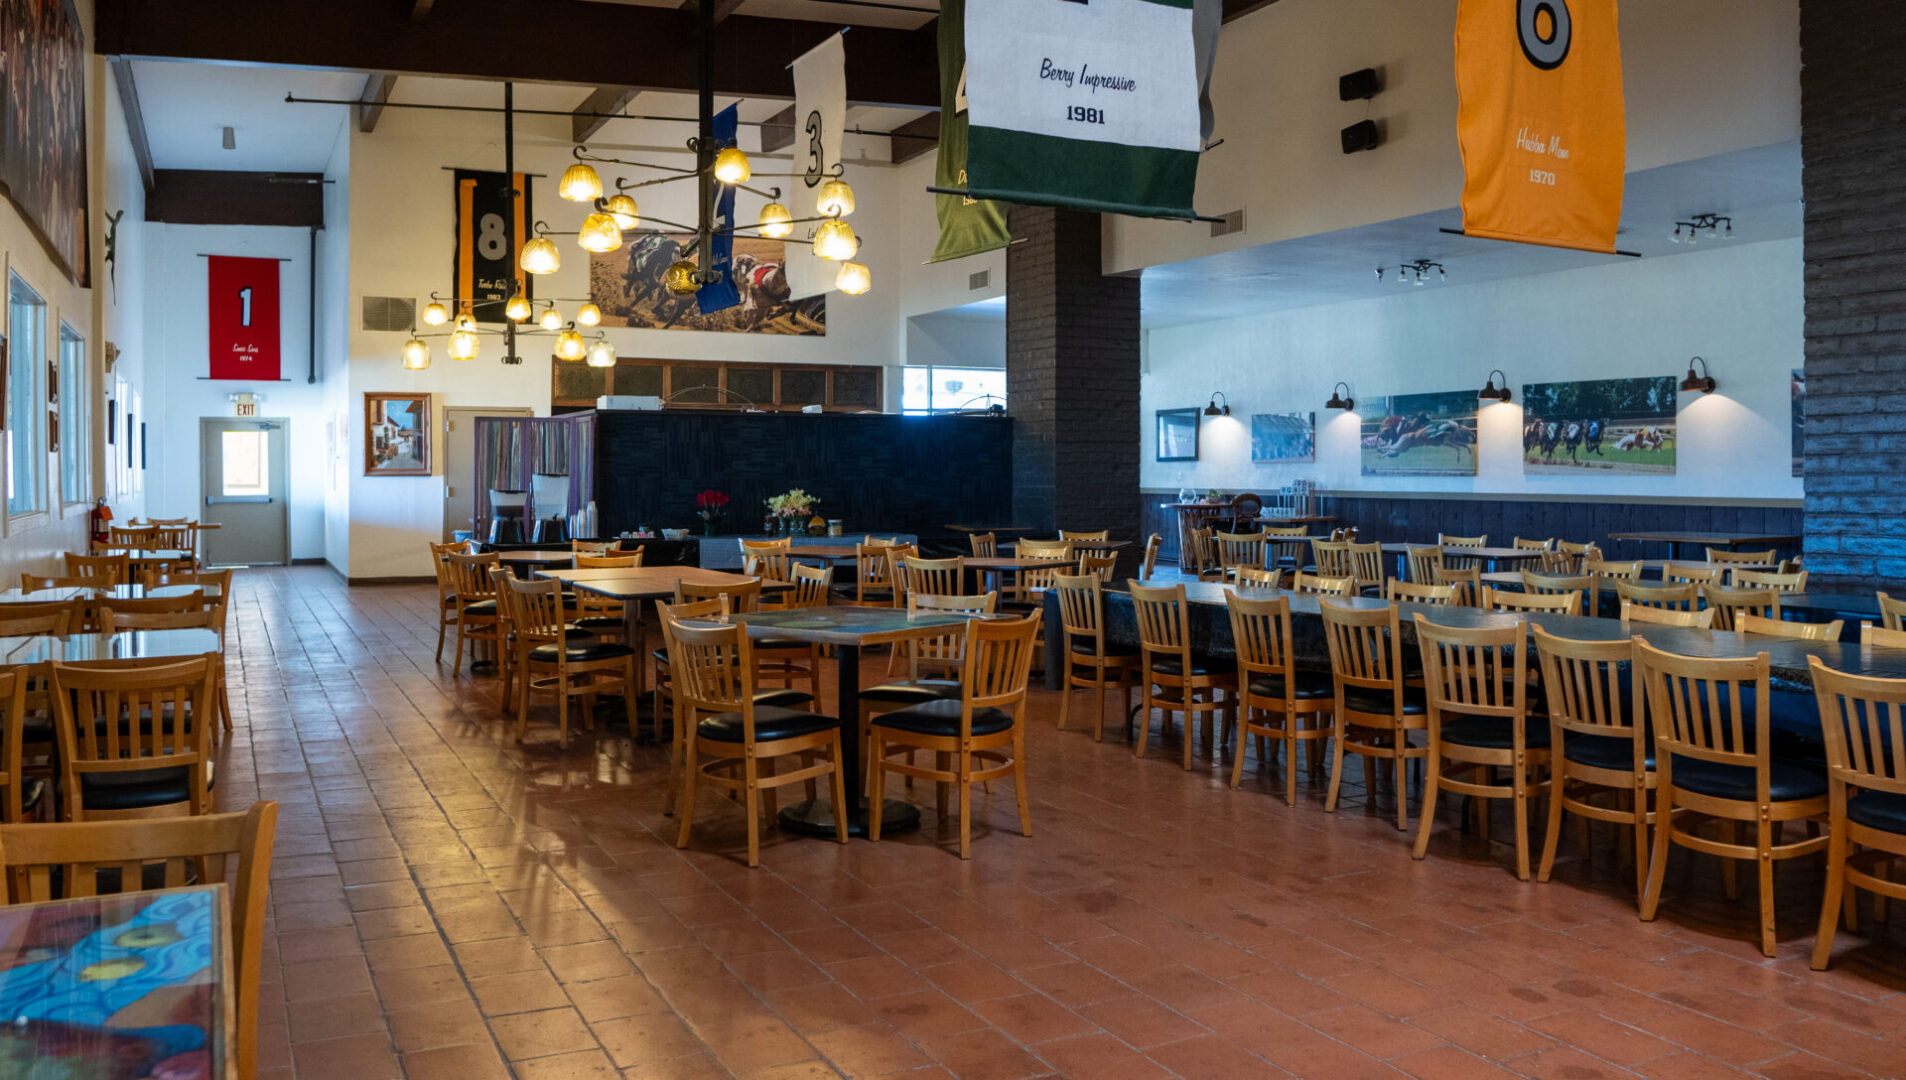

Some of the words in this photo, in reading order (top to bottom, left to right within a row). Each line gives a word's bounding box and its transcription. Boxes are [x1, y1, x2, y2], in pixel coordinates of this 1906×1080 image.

[1039, 57, 1075, 88] Berry
[1079, 63, 1136, 94] Impressive
[1066, 105, 1105, 124] 1981
[804, 110, 824, 188] 3
[1529, 168, 1556, 186] 1970
[478, 213, 507, 260] 8
[239, 286, 252, 327] 1
[236, 403, 255, 416] EXIT
